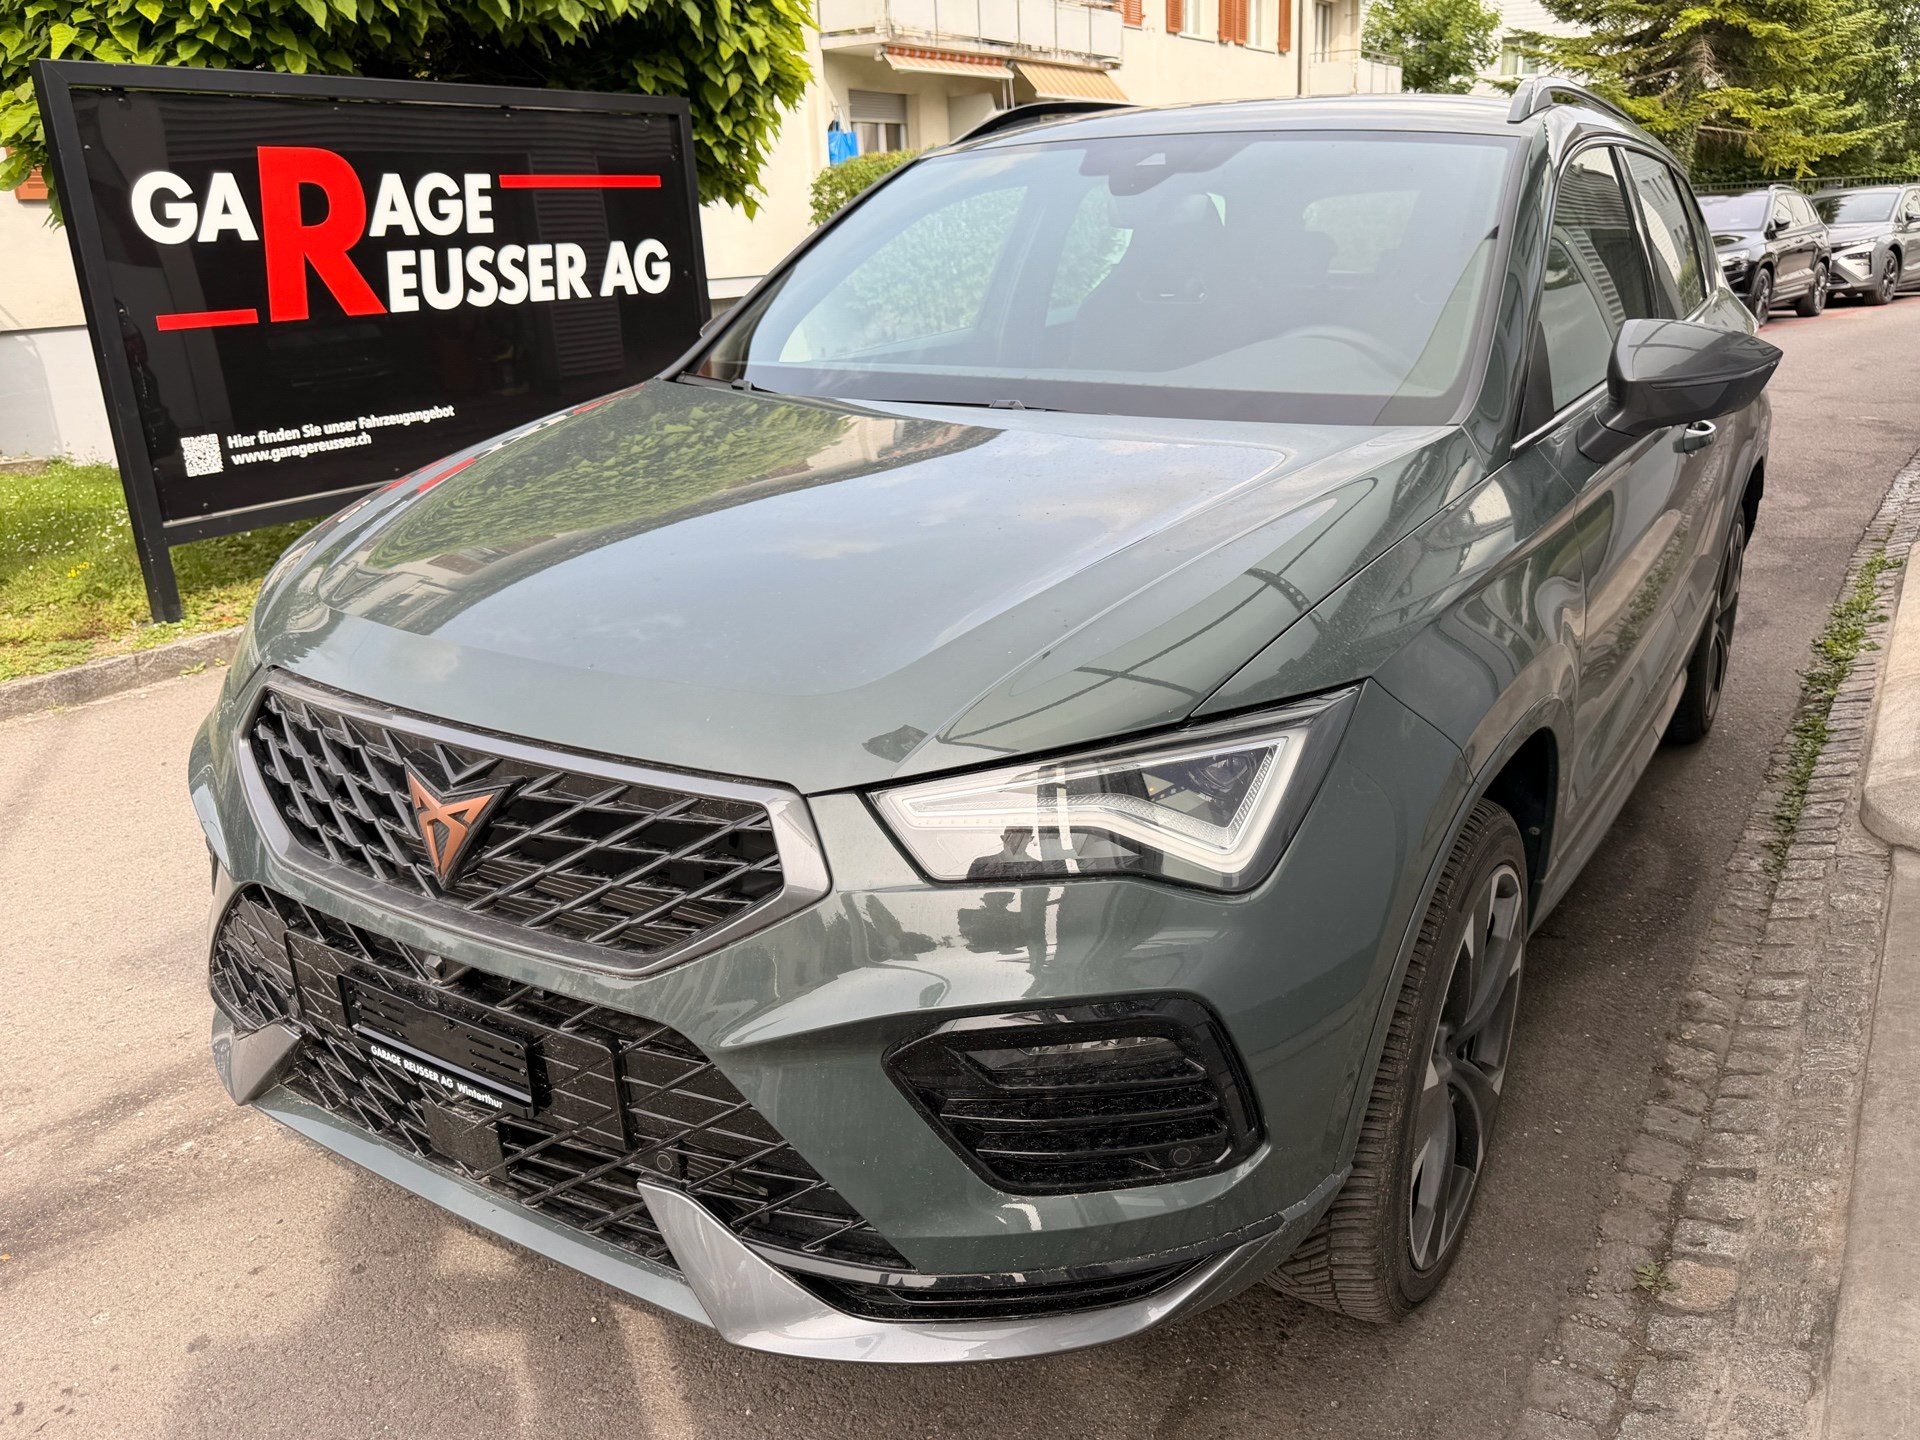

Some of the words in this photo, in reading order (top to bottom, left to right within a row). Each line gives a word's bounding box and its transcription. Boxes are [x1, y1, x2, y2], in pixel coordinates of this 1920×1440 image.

[131, 146, 494, 322] GARAGE
[600, 239, 671, 297] AG
[227, 432, 256, 449] Hier
[258, 427, 301, 444] finden
[303, 423, 322, 438] Sie
[325, 421, 357, 435] unser
[359, 405, 455, 430] Fahrzeugangebot
[231, 433, 372, 465] www.garagereusser.ch
[371, 1045, 402, 1067] GARAGE
[403, 1059, 440, 1083] REUSSER
[440, 1075, 454, 1089] AG
[457, 1083, 503, 1109] Winterthur
